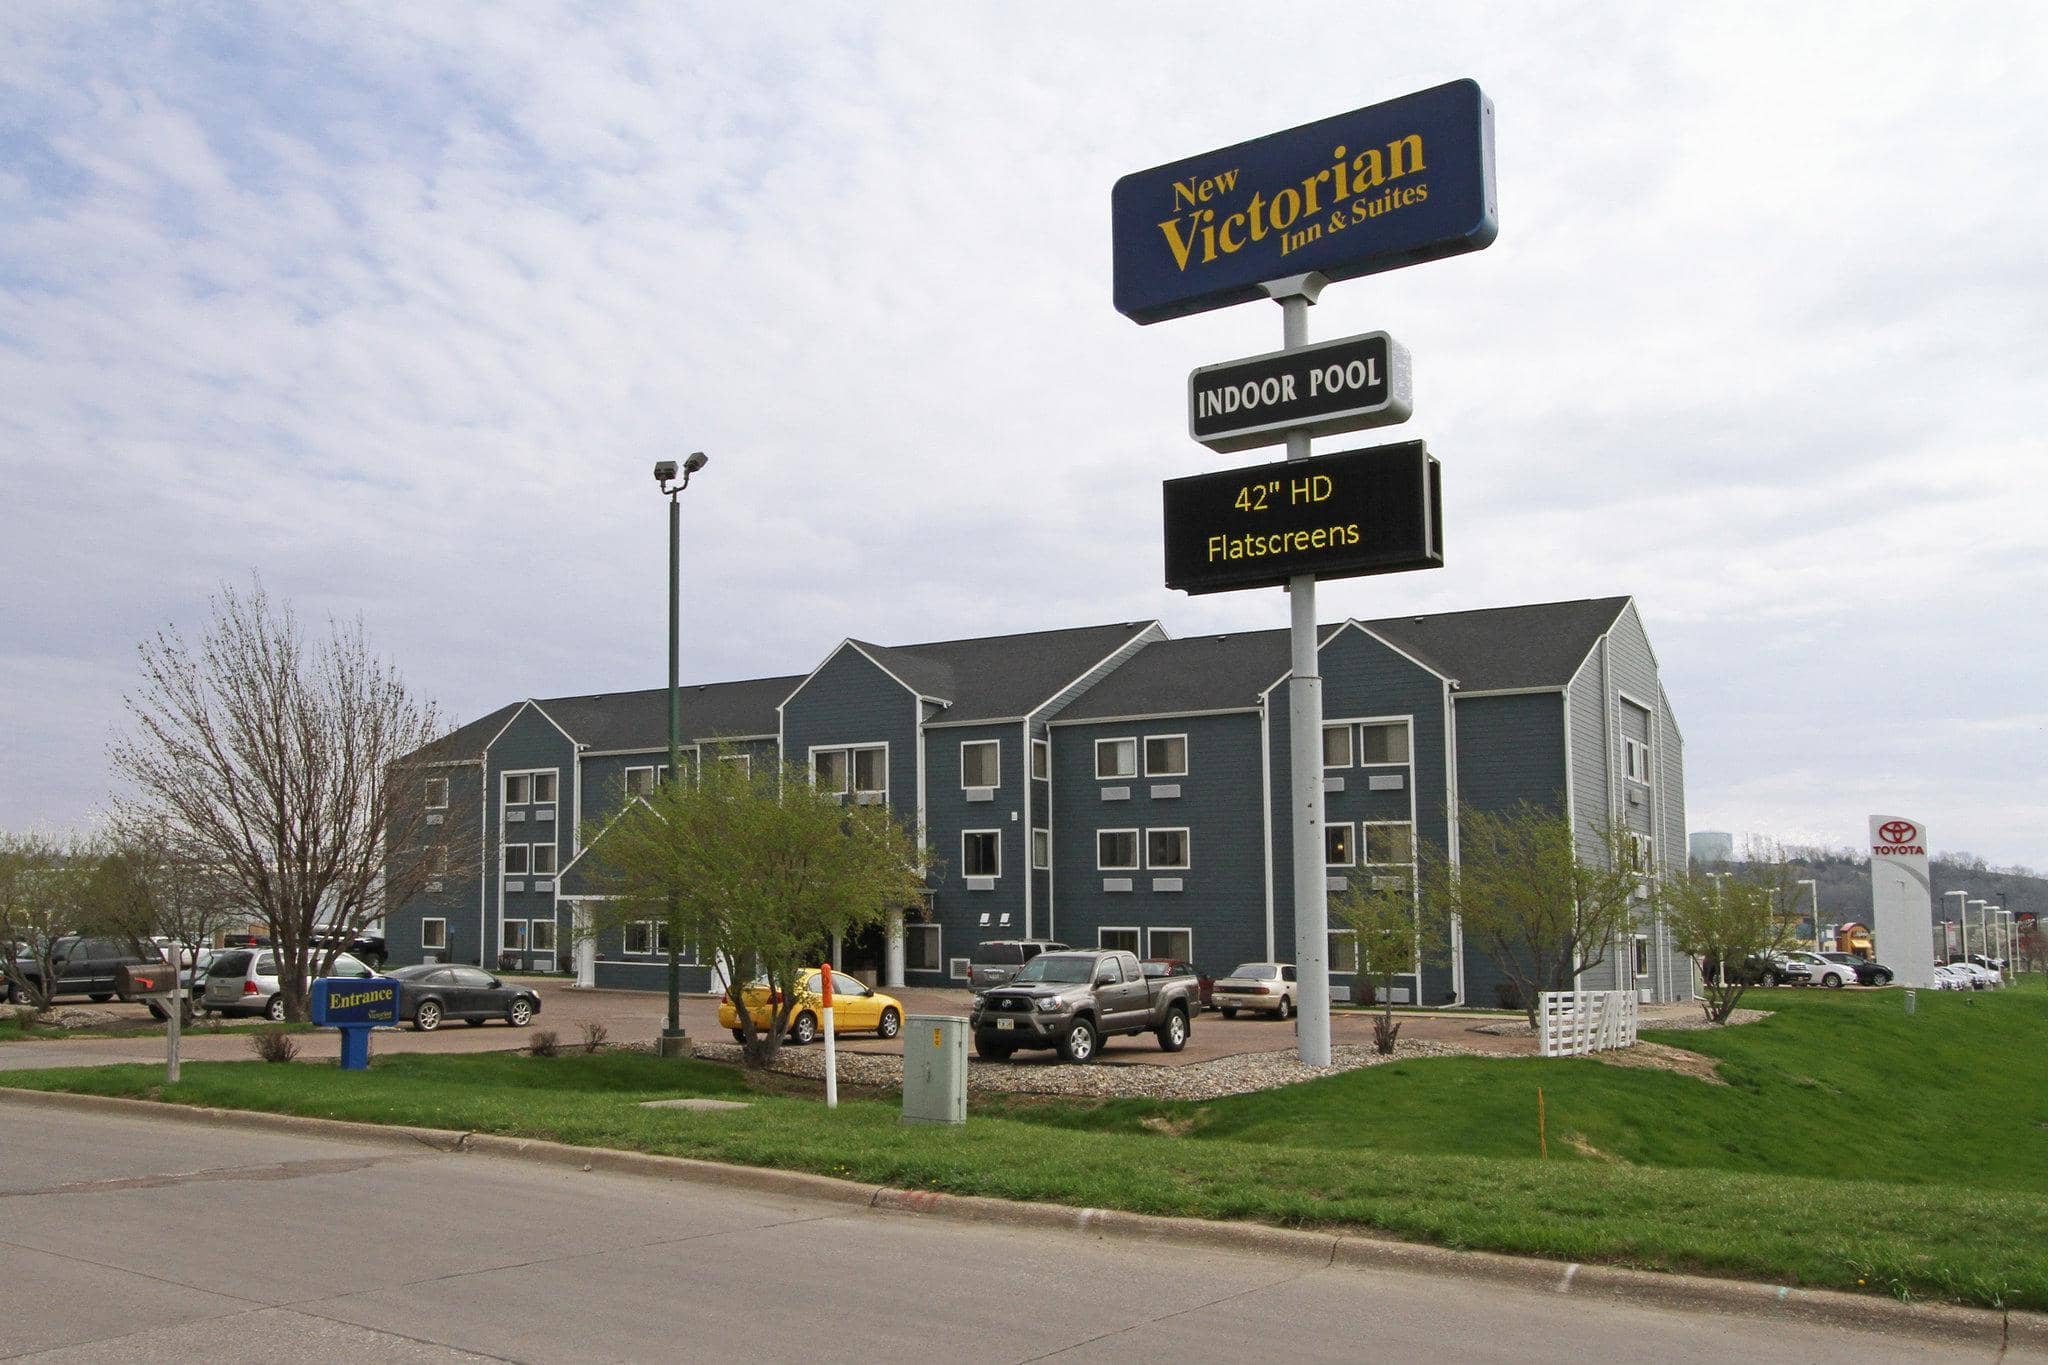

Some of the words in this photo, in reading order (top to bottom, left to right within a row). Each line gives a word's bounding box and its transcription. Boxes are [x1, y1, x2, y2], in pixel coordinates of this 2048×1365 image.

[1158, 132, 1426, 272] Victorian
[1172, 168, 1240, 212] New
[1280, 223, 1322, 257] Inn
[1327, 212, 1348, 234] &
[1351, 184, 1428, 225] Suites
[1199, 374, 1297, 418] INDOOR
[1310, 358, 1381, 397] POOL
[1234, 480, 1280, 512] 42"
[1291, 475, 1332, 505] HD
[1208, 523, 1360, 561] Flatscreens
[1873, 845, 1925, 855] TOYOTA
[330, 988, 393, 1009] Entrance
